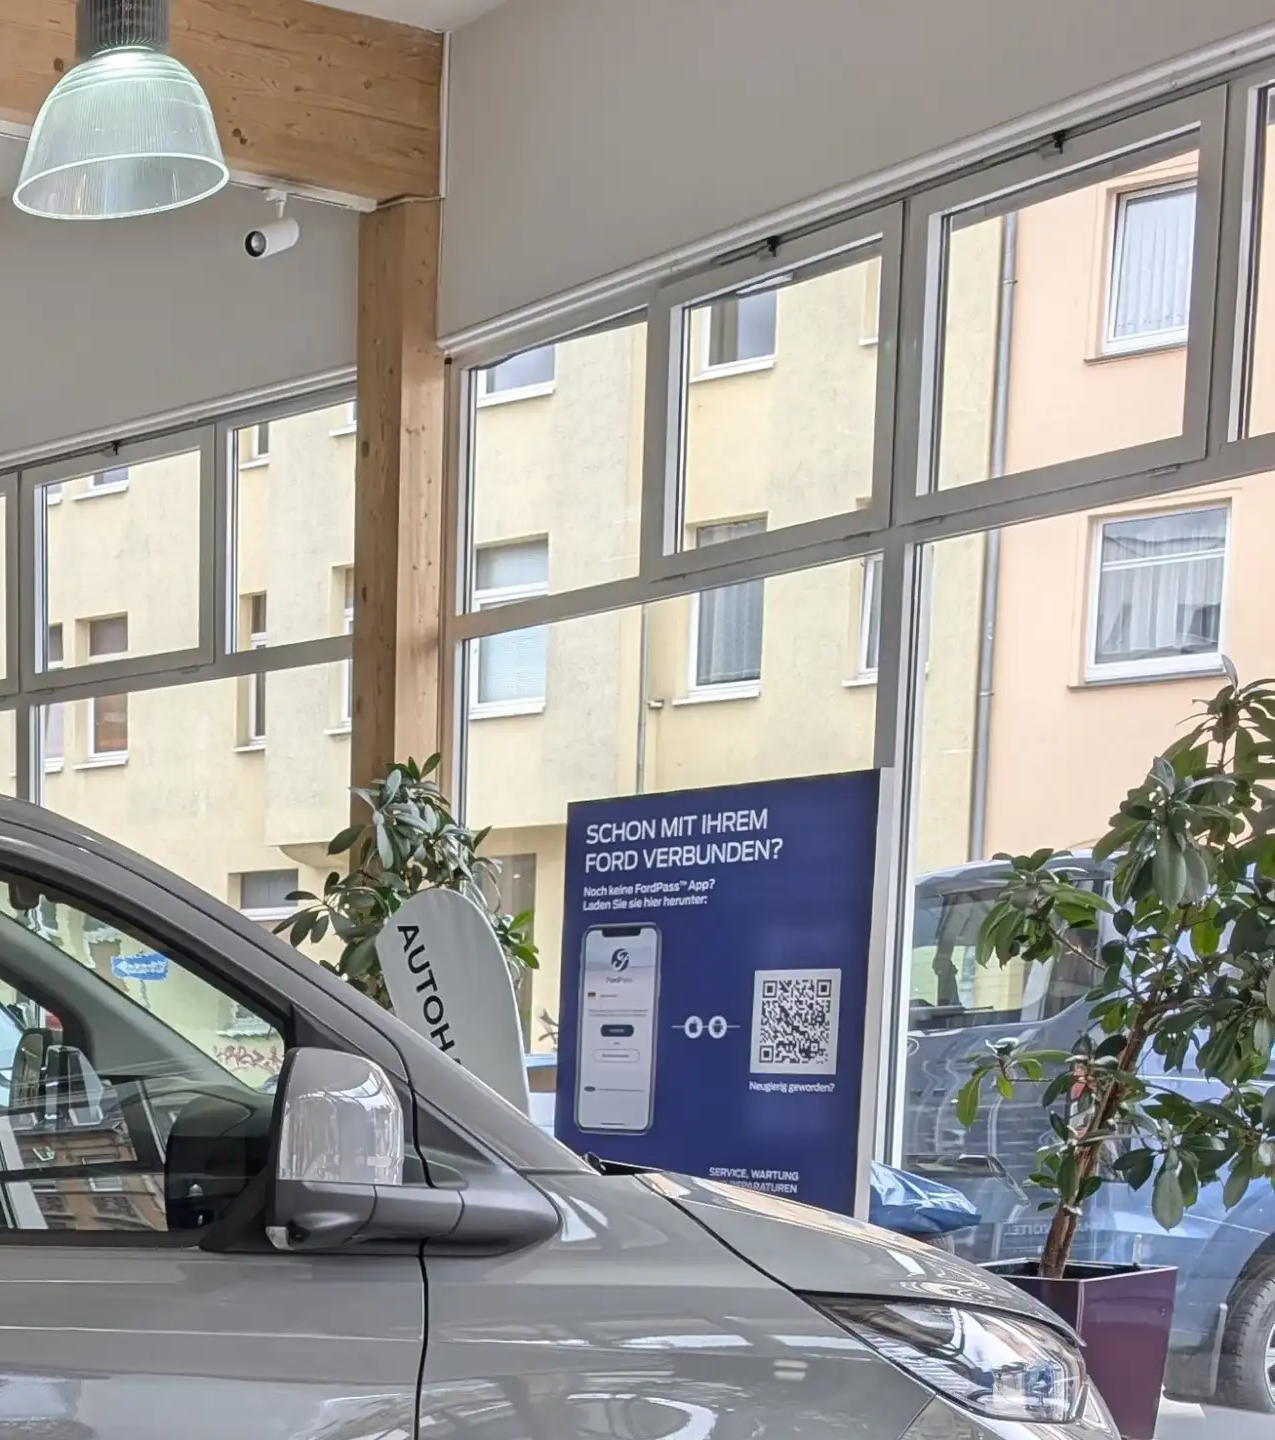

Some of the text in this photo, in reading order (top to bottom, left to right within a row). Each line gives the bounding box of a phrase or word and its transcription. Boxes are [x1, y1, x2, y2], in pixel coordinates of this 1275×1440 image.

[585, 808, 769, 845] SCHON MIT IHREM
[584, 838, 784, 874] FORD VERBUNDEN?
[583, 885, 608, 898] Noch
[608, 884, 634, 896] keine
[688, 878, 716, 892] App?
[582, 900, 611, 912] Laden
[612, 899, 627, 910] Sie
[628, 897, 643, 909] sie
[643, 896, 662, 908] hier
[397, 925, 461, 1065] AUTOH
[748, 1081, 835, 1094] Neugierig geworden?
[750, 1169, 799, 1182] WARTUNG
